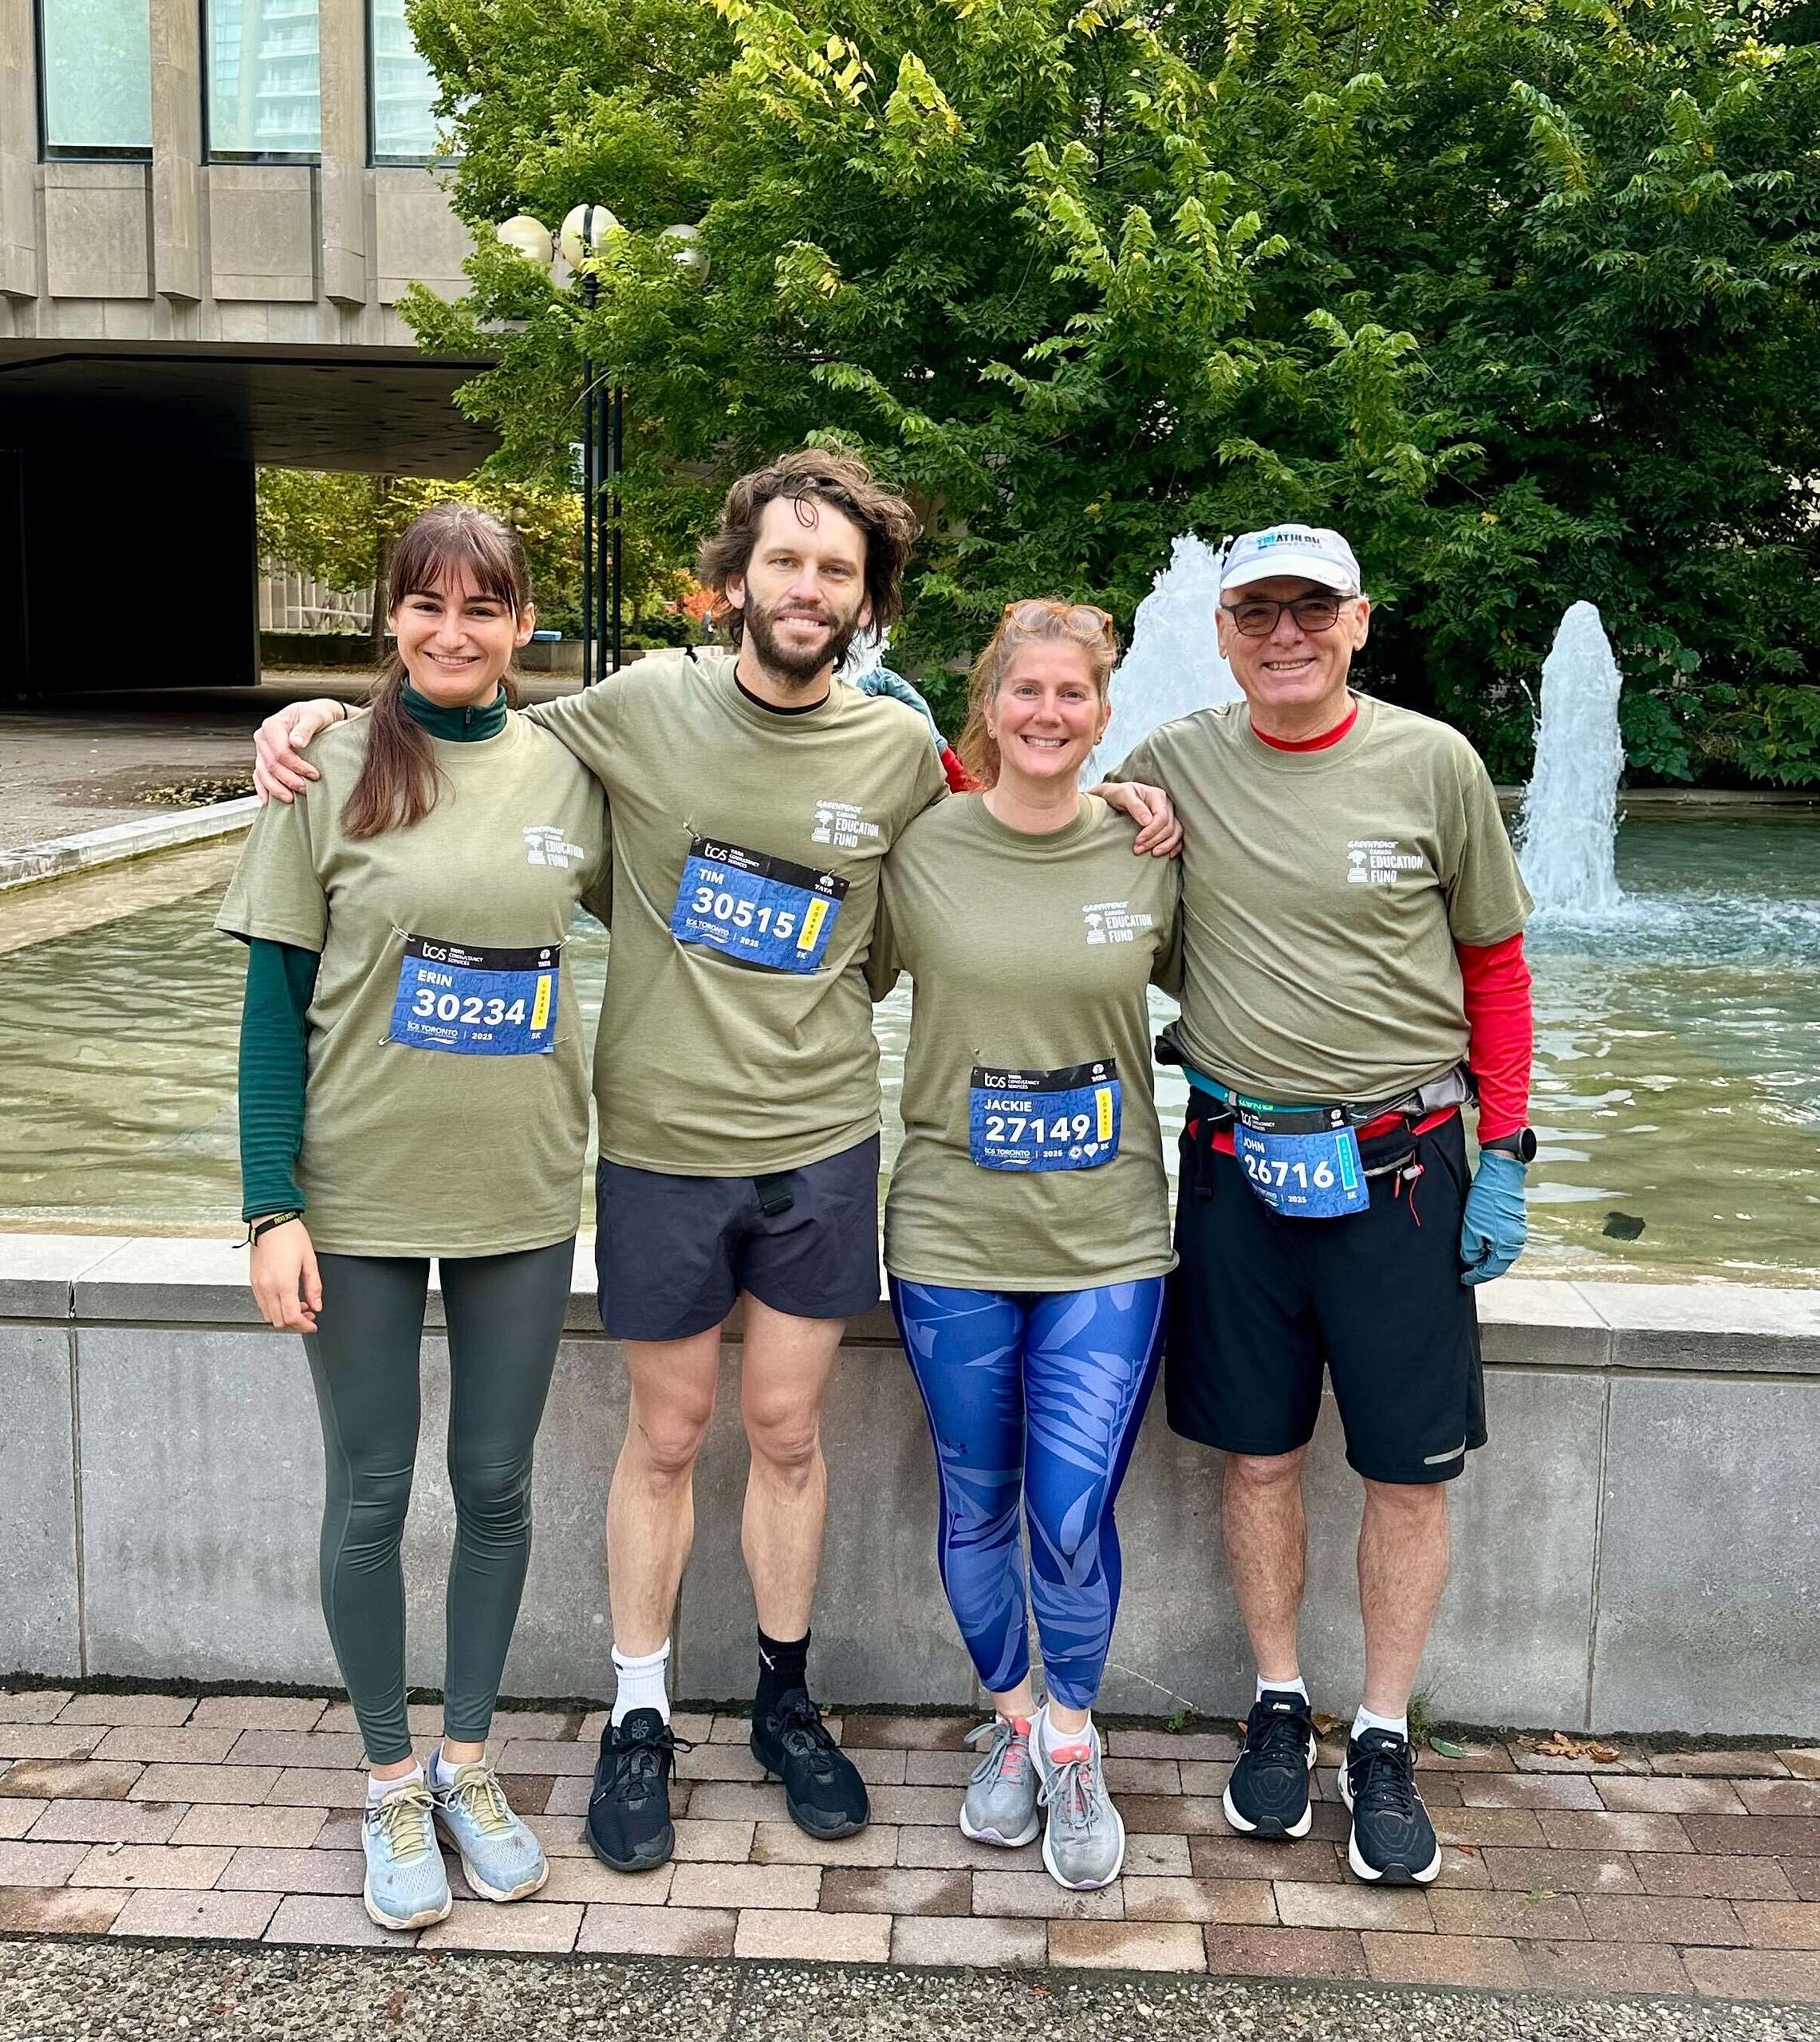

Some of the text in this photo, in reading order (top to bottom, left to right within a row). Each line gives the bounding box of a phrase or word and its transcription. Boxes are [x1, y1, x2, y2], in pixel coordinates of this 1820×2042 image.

[836, 818, 879, 838] EDUCATION
[833, 832, 858, 848] FUND
[546, 840, 585, 859] EDUCATION
[704, 843, 727, 861] tcs
[547, 854, 568, 868] FUND
[1370, 856, 1423, 869] EDUCATION
[699, 869, 724, 885] TIM
[1371, 870, 1397, 883] FUND
[814, 885, 833, 894] TATA
[691, 887, 796, 938] 30515
[803, 906, 821, 940] CORRAL
[1105, 914, 1152, 929] EDUCATION
[698, 920, 729, 936] TORONTO
[740, 936, 759, 948] 2025
[1109, 929, 1133, 943] FUND
[422, 941, 447, 960] tcs
[417, 970, 452, 987] ERIN
[412, 989, 525, 1025] 30234
[421, 1026, 458, 1035] TORONTO
[984, 1073, 1006, 1088] tcs
[984, 1098, 1033, 1112] JACKIE
[986, 1114, 1090, 1142] 27149
[1243, 1136, 1265, 1153] JOHN
[1244, 1154, 1334, 1189] 26716
[1288, 1195, 1306, 1204] 2025
